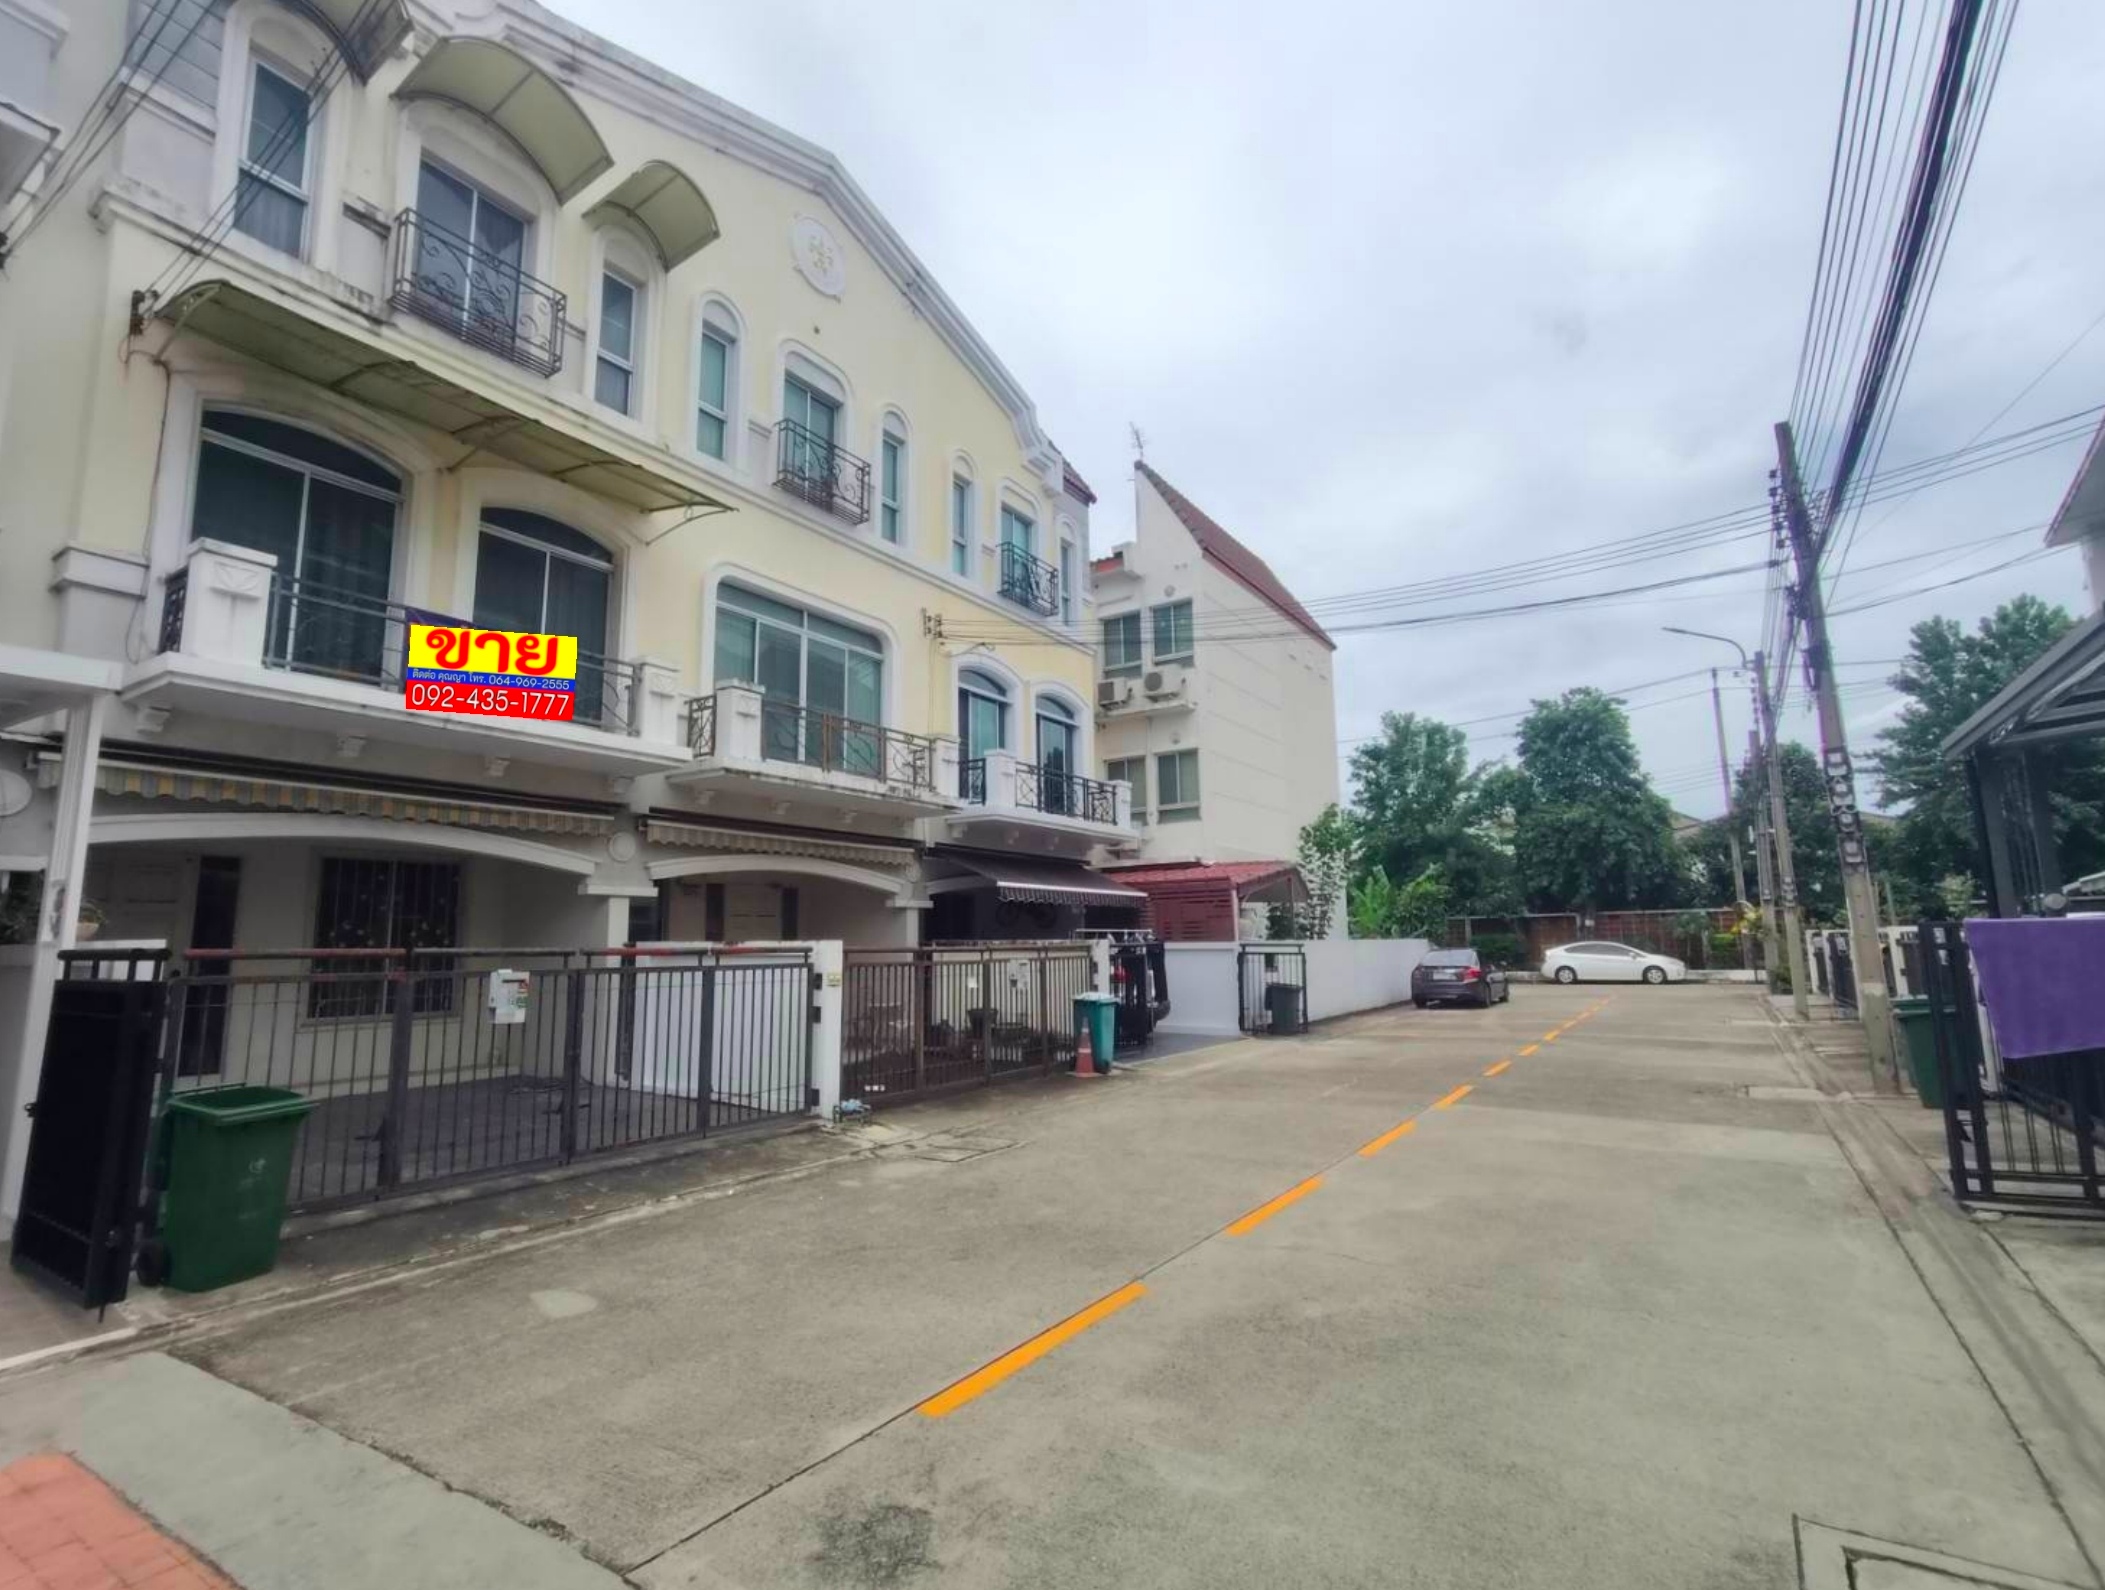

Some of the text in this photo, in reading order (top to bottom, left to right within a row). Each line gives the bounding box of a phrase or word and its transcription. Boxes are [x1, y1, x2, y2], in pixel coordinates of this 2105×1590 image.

[426, 628, 558, 675] ขาย
[412, 668, 436, 680] ติดต่อ
[468, 671, 487, 684] โทร.
[488, 674, 570, 690] 064-969-2555
[411, 683, 570, 716] 092-435-1777
